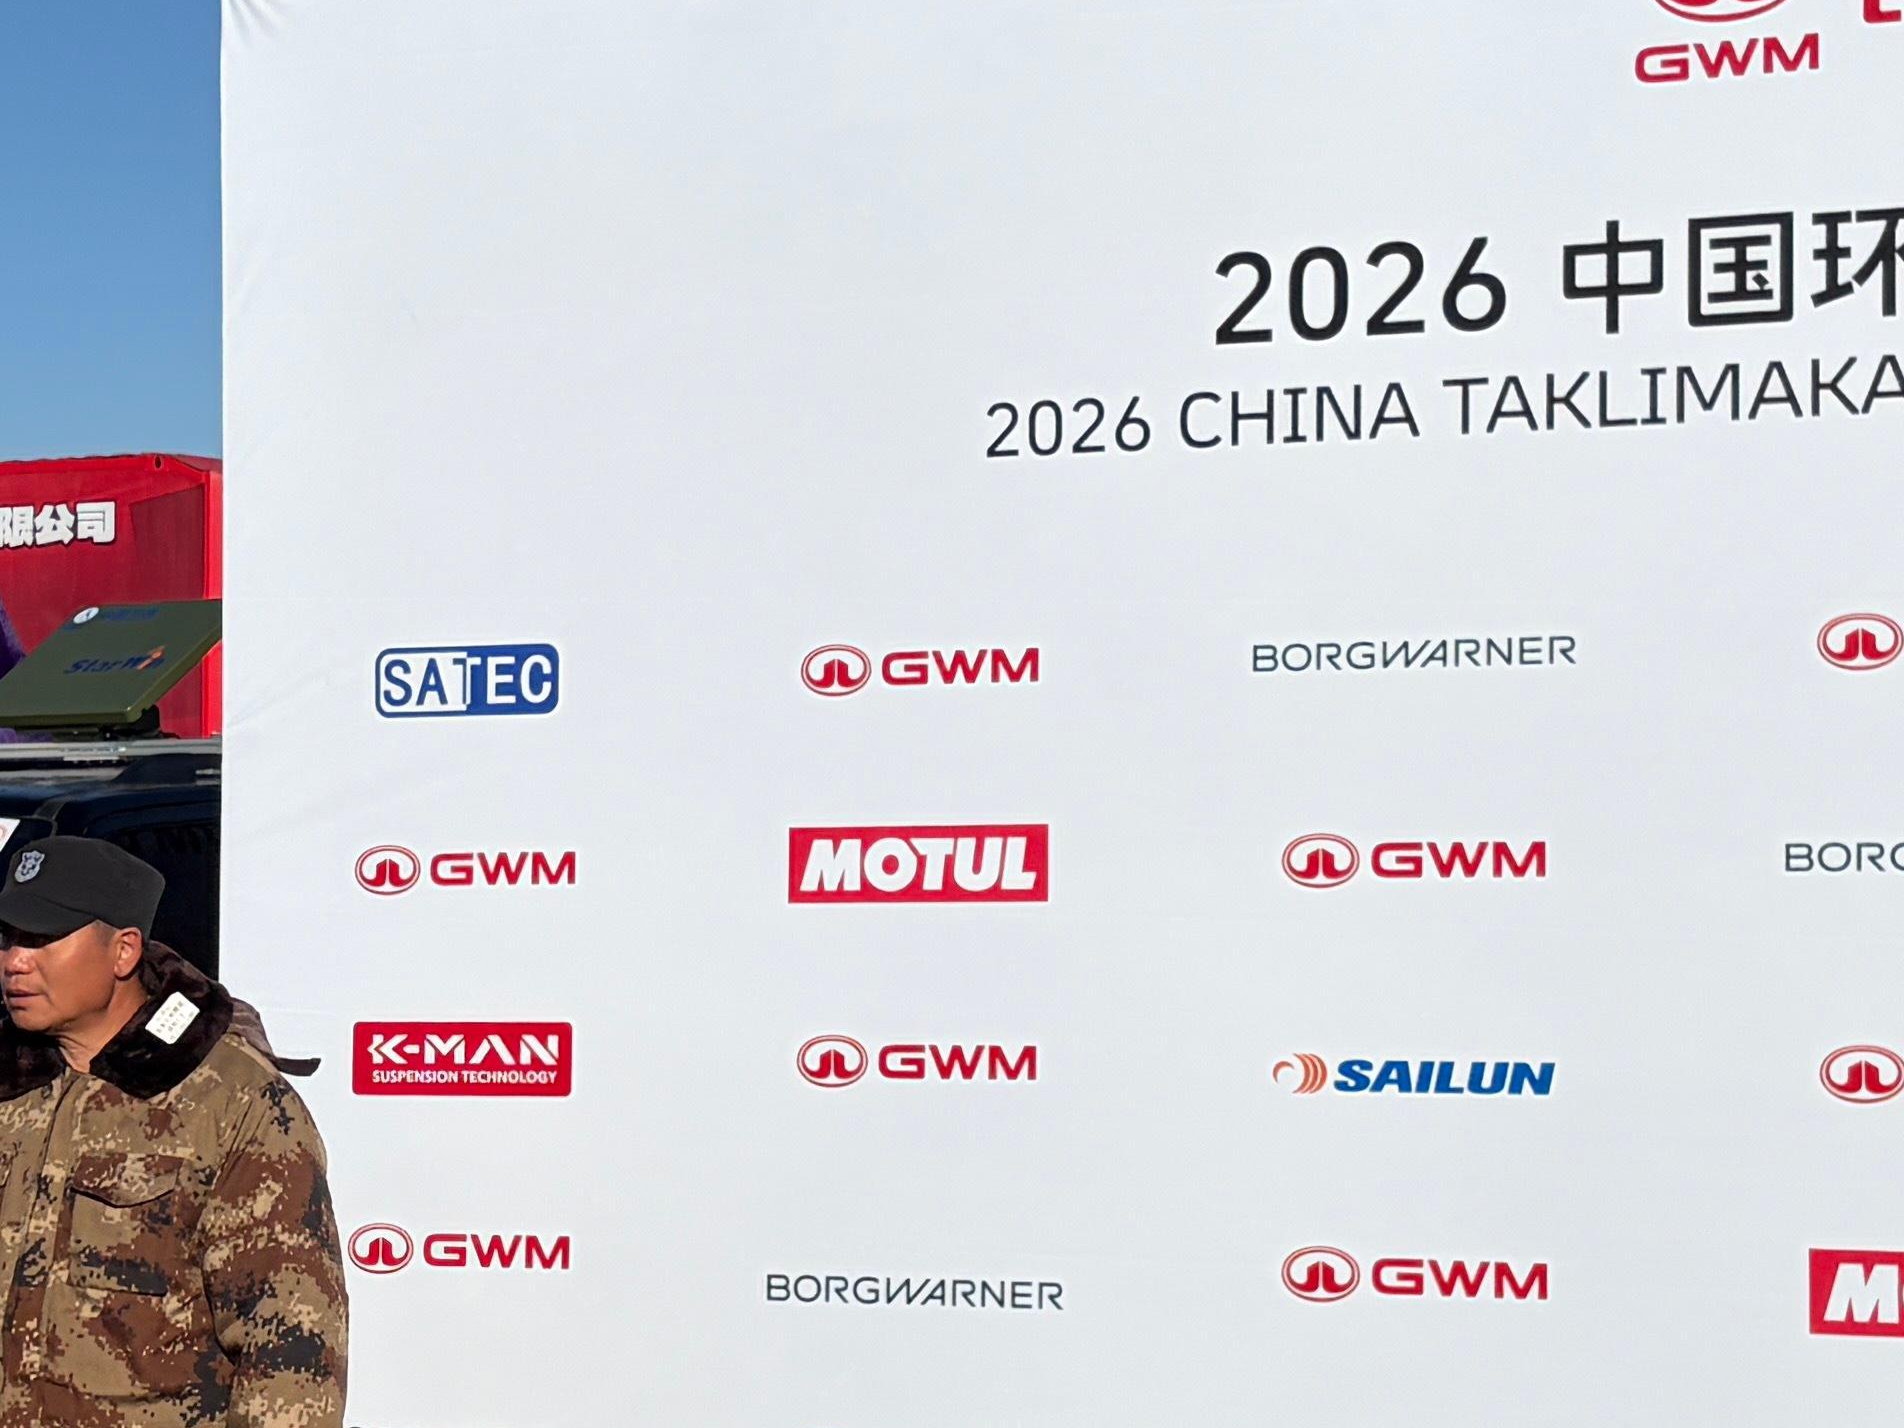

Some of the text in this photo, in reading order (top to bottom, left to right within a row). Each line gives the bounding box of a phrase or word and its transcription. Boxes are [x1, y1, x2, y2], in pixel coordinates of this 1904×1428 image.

[1634, 32, 1819, 83] GWM
[1215, 236, 1507, 345] 2026
[986, 395, 1151, 458] 2026
[1179, 382, 1420, 449] CHINA
[881, 647, 1039, 686] GWM
[1252, 635, 1576, 673] BORGWARNER
[383, 654, 552, 707] SATEC
[430, 851, 576, 886] GWM
[799, 836, 1037, 893] MOTUL
[1371, 841, 1546, 878] GWM
[367, 1034, 559, 1066] K-MAN
[878, 1044, 1037, 1081] GWM
[372, 1069, 557, 1084] SUSPENSION TECHNOLOGY
[1333, 1059, 1556, 1095] SAILUN
[423, 1233, 570, 1270] GWM
[766, 1274, 1063, 1310] BORGWARNER
[1371, 1258, 1548, 1300] GWM
